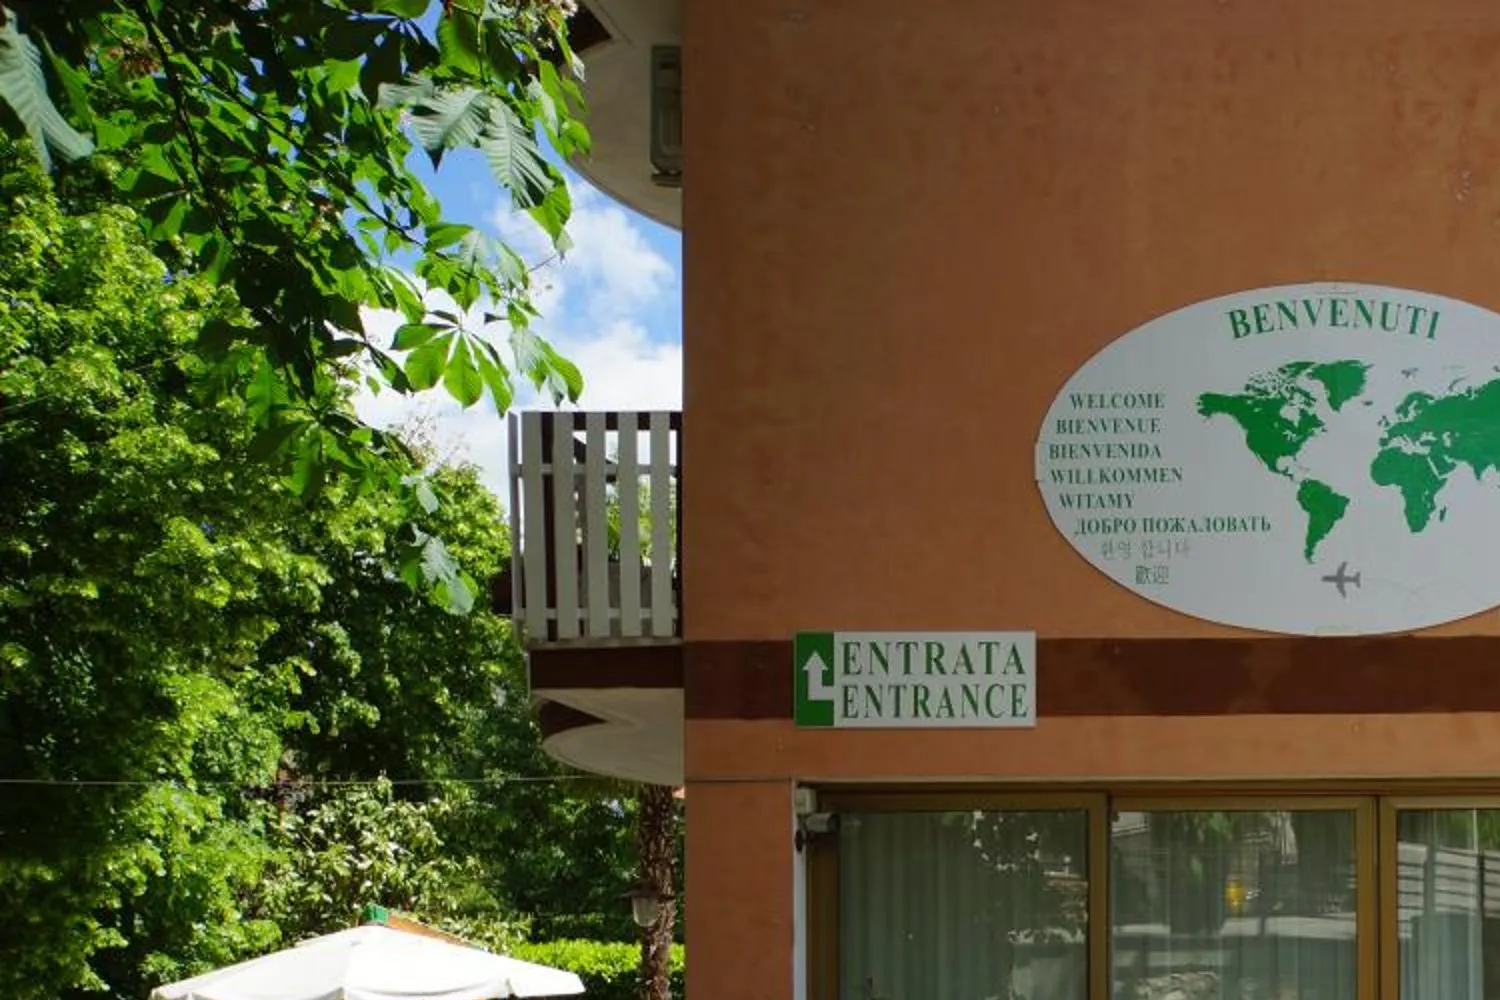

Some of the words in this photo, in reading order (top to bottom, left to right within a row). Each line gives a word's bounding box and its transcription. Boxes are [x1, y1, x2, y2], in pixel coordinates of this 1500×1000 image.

[1226, 299, 1441, 340] BENVENUTI
[1069, 393, 1165, 410] WELCOME
[1056, 418, 1161, 435] BIENVENUE
[1049, 443, 1162, 460] BIENVENIDA
[1050, 467, 1183, 485] WILLKOMMEN
[1059, 492, 1135, 509] WITAMY
[1074, 517, 1137, 536] ДОБРО
[1142, 515, 1272, 535] ПОЖАЛОВАТЬ
[841, 641, 1026, 676] ENTRATA
[841, 683, 1028, 719] ENTRANCE
